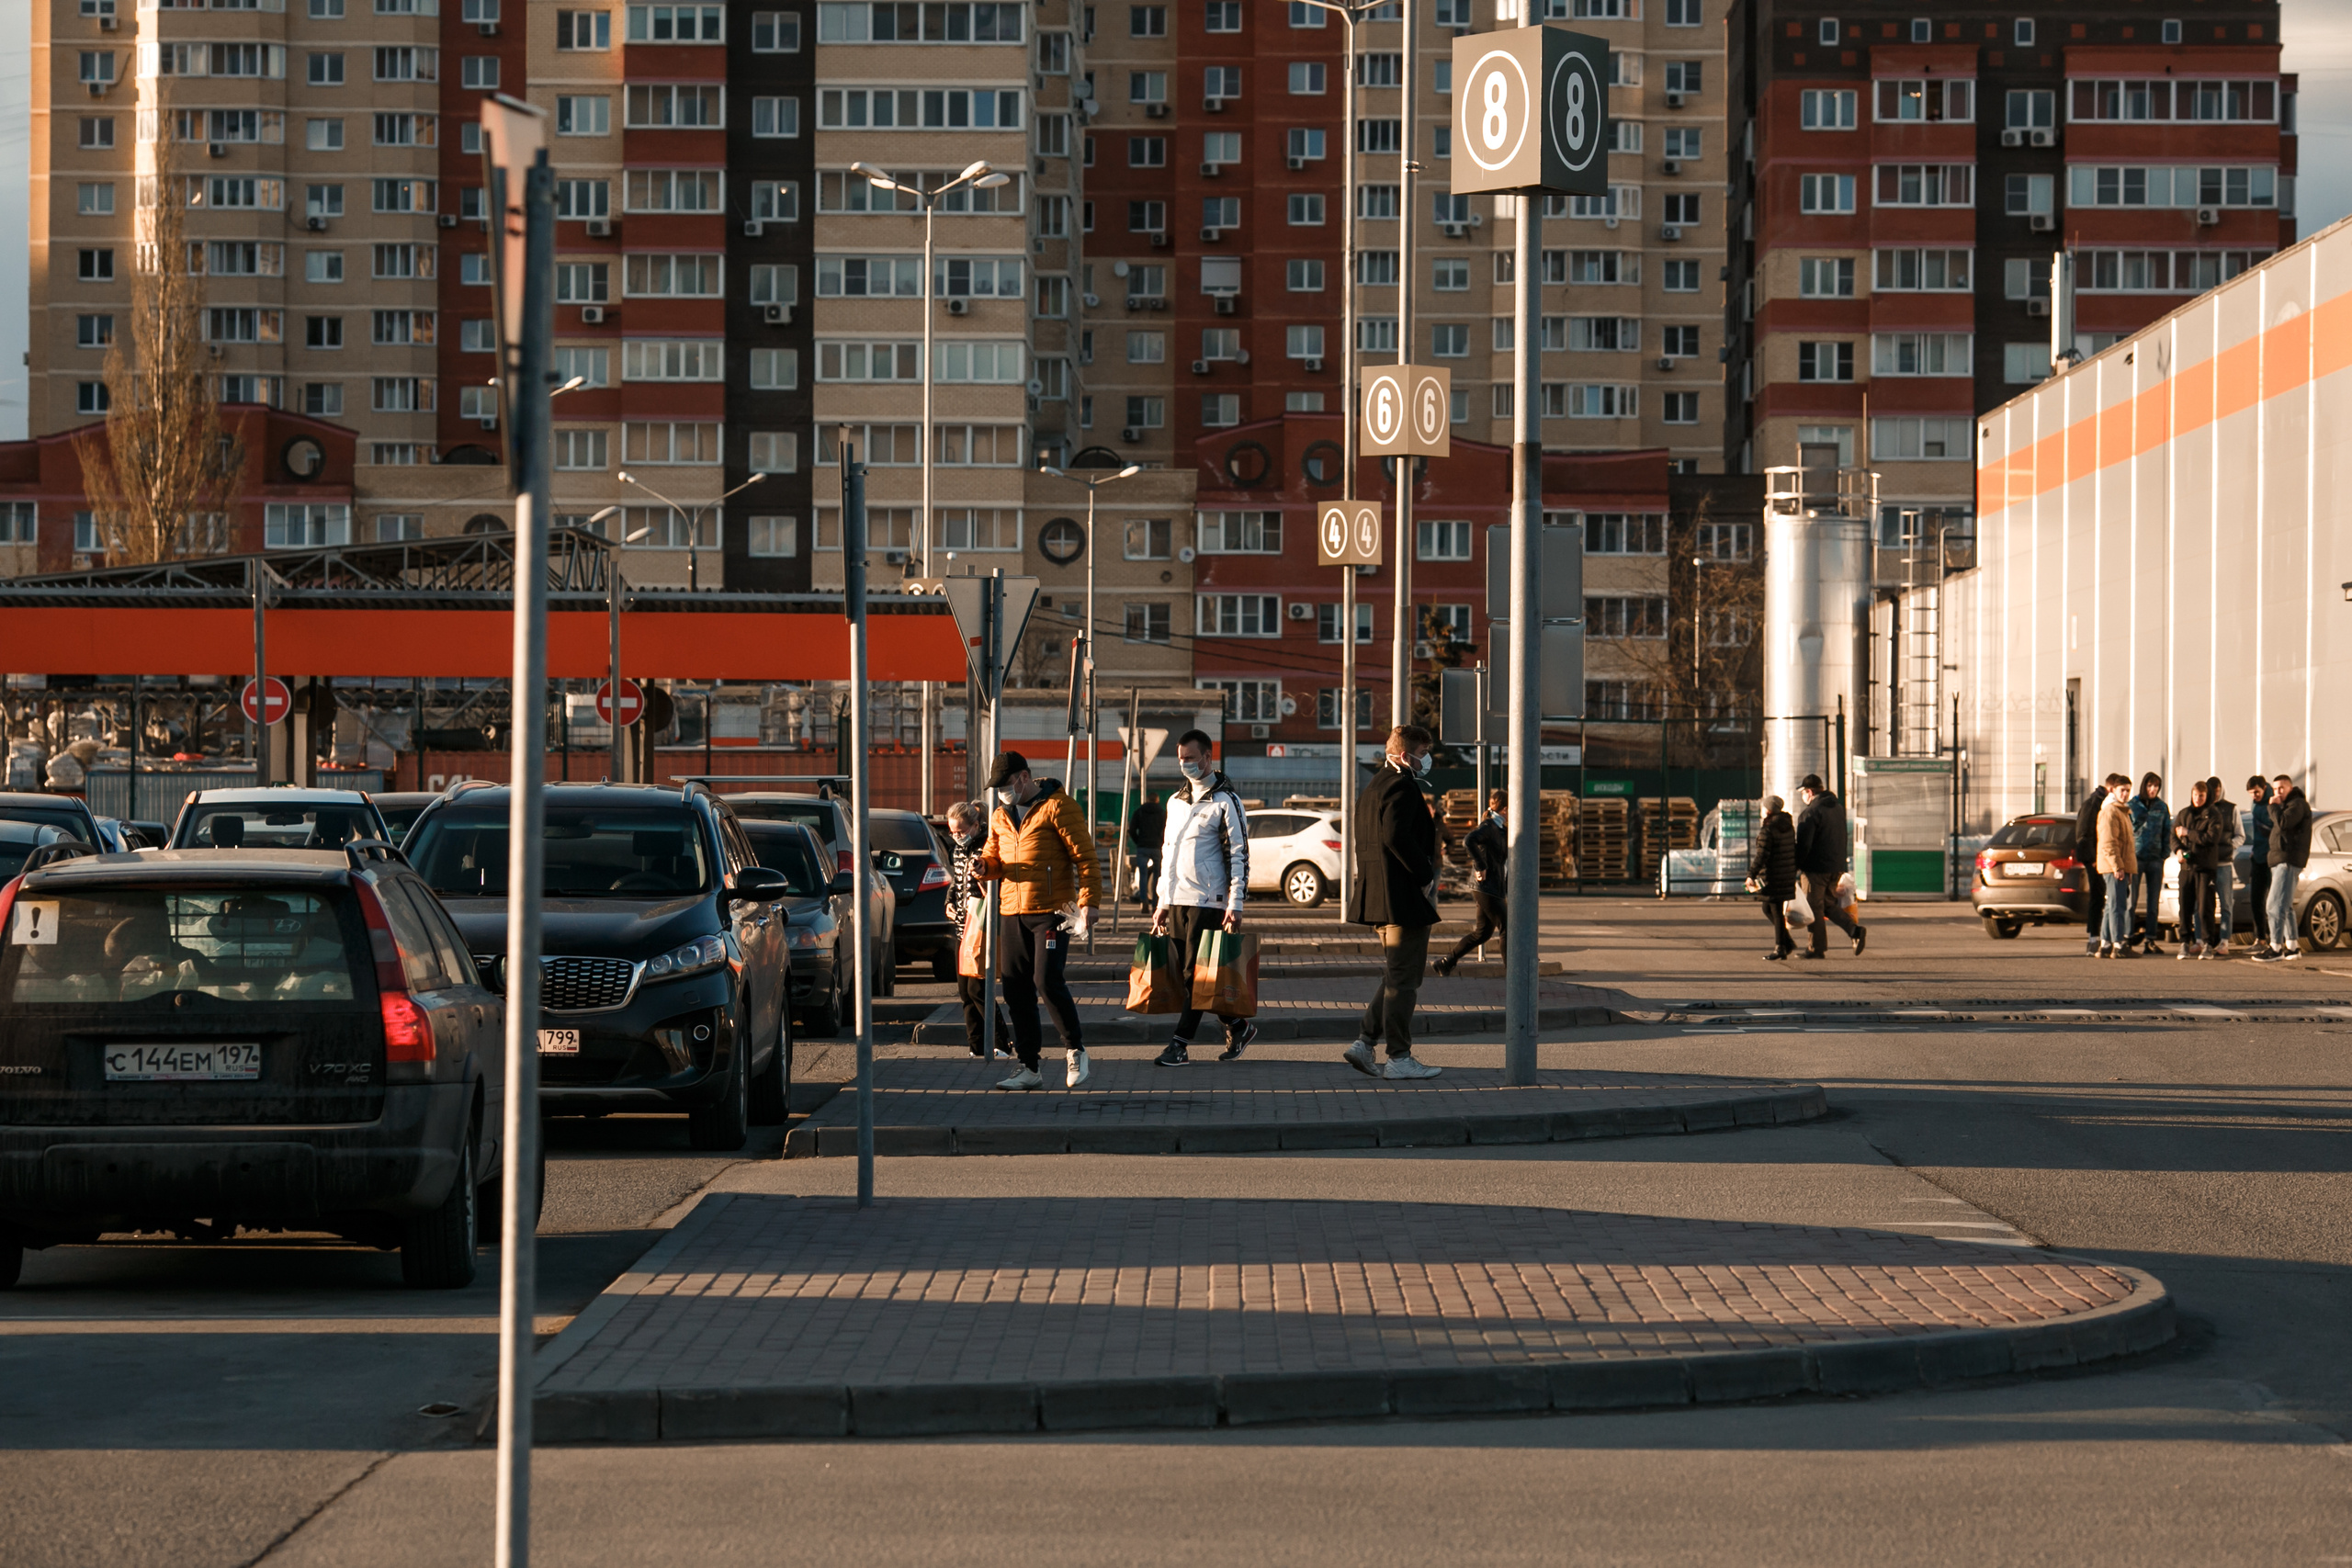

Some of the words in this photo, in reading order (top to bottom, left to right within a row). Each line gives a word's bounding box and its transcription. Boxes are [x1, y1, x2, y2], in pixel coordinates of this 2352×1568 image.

[1482, 71, 1508, 150] 8
[1566, 72, 1585, 151] 8
[1377, 387, 1392, 434] 6
[1423, 388, 1436, 434] 6
[1329, 516, 1341, 549] 4
[1361, 516, 1373, 549] 4
[546, 1031, 574, 1045] 799
[217, 1045, 254, 1065] 197
[345, 1075, 369, 1083] AWD
